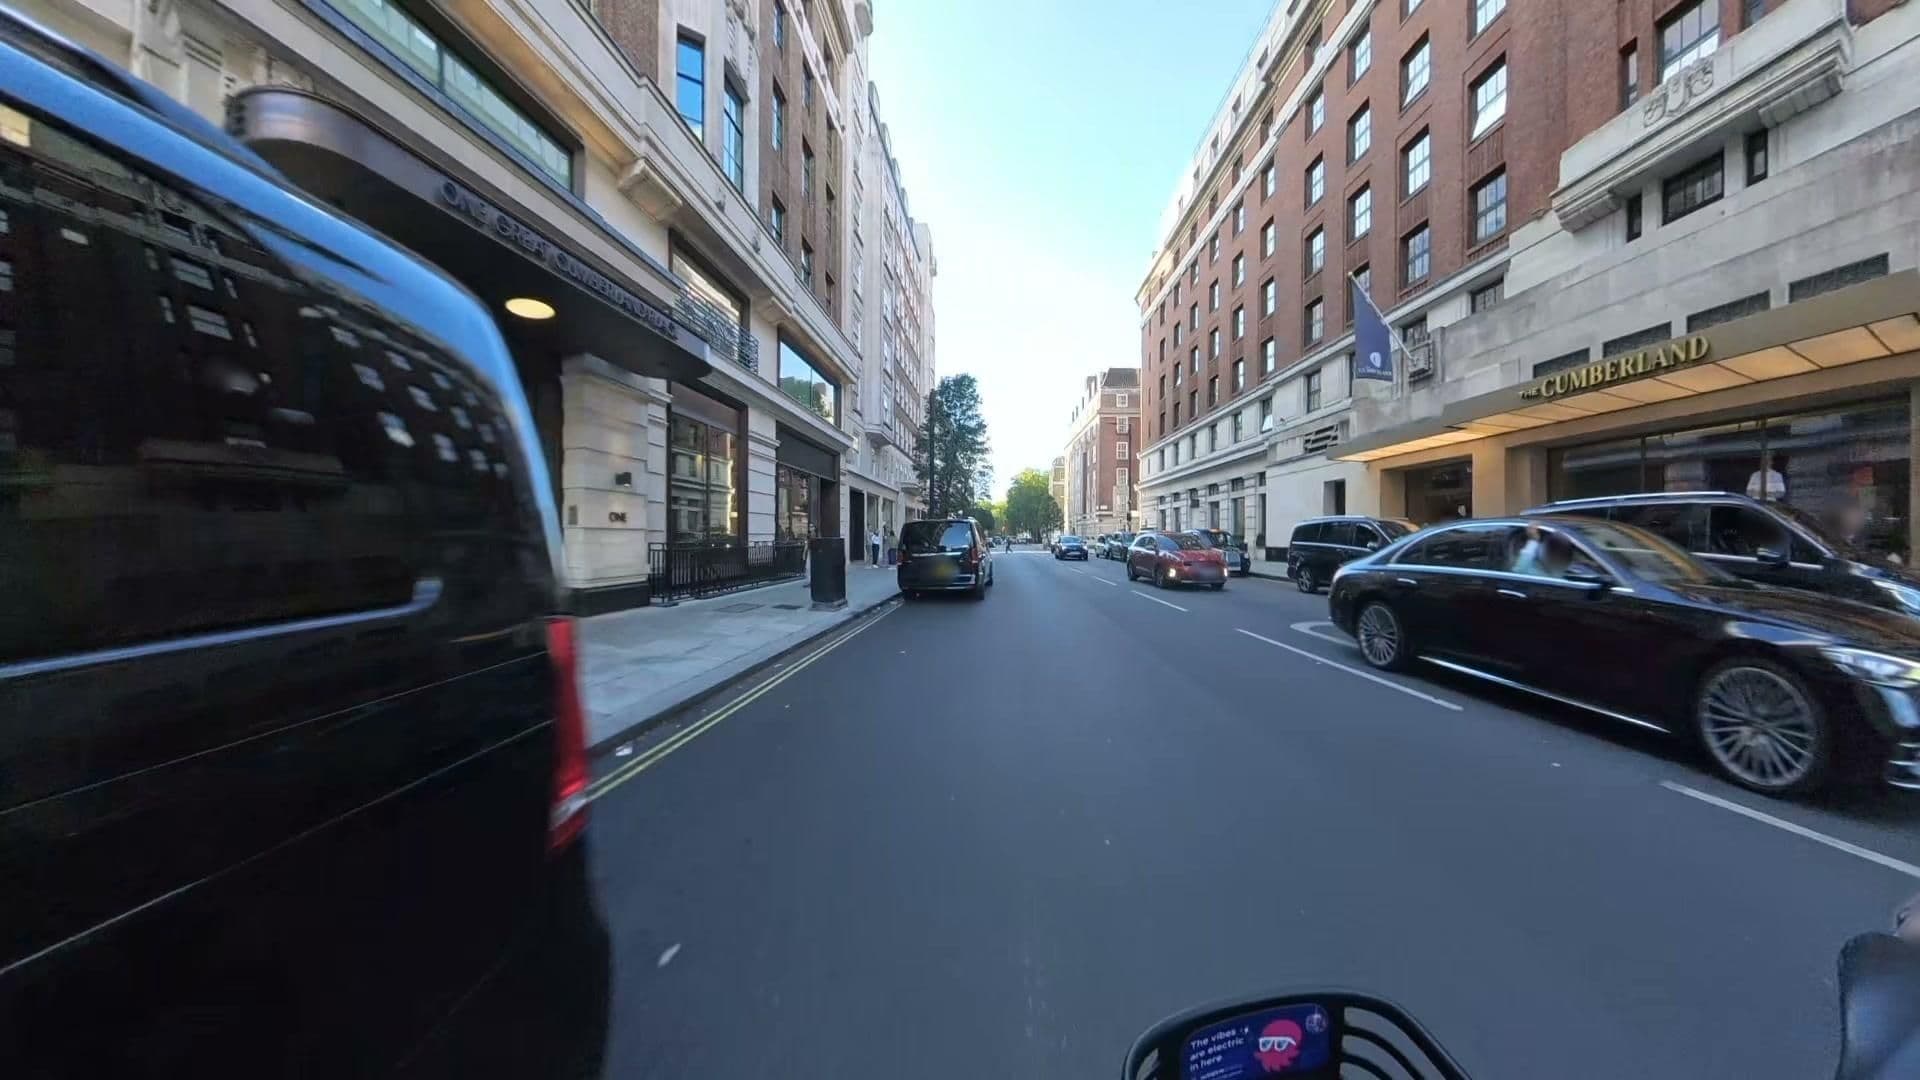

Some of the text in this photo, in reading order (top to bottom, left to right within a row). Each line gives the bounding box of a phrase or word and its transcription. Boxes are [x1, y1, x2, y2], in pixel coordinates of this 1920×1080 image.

[1519, 336, 1711, 400] THE CUMBERLAND
[1190, 1029, 1236, 1049] The vibes
[1190, 1037, 1244, 1061] are electric
[1200, 1055, 1222, 1069] here
